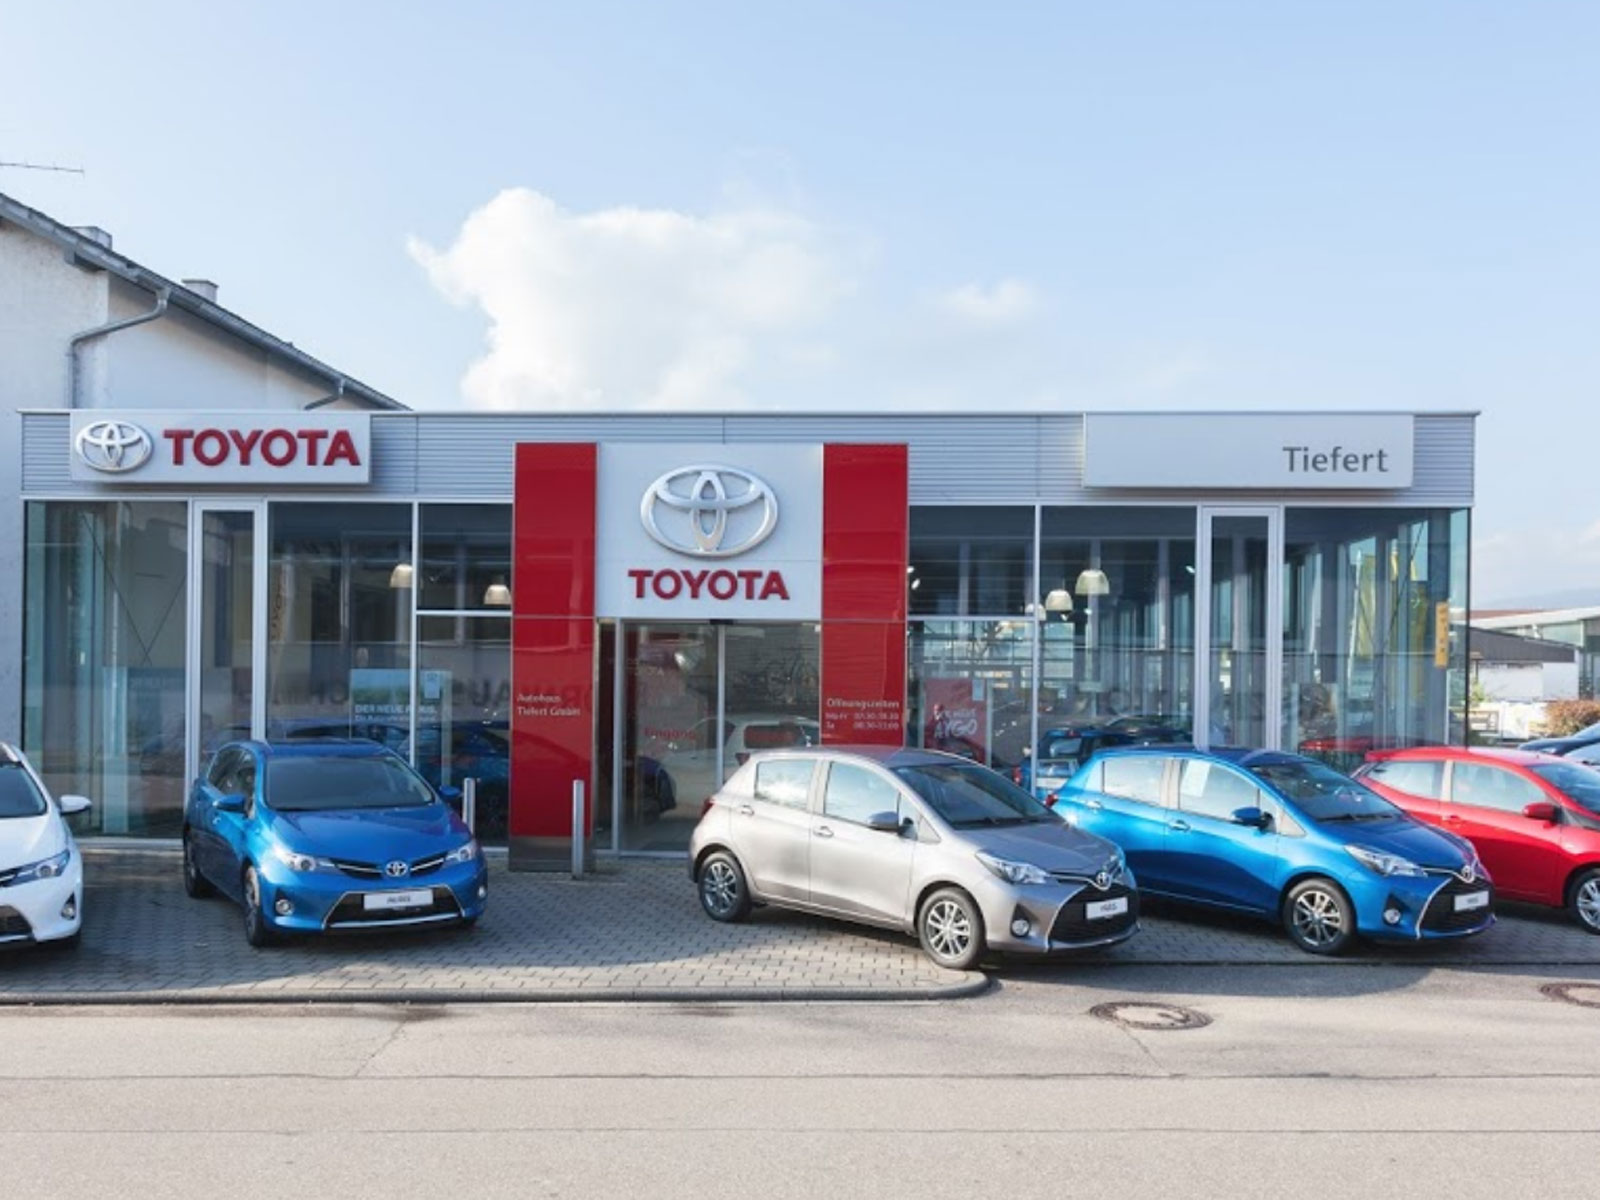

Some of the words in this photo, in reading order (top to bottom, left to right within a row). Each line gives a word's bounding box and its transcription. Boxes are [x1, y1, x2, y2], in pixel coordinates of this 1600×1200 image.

[163, 429, 361, 467] TOYOTA
[1282, 446, 1389, 472] Tiefert
[627, 568, 790, 600] TOYOTA
[517, 693, 561, 702] Autohaus
[517, 706, 547, 716] Tiefert
